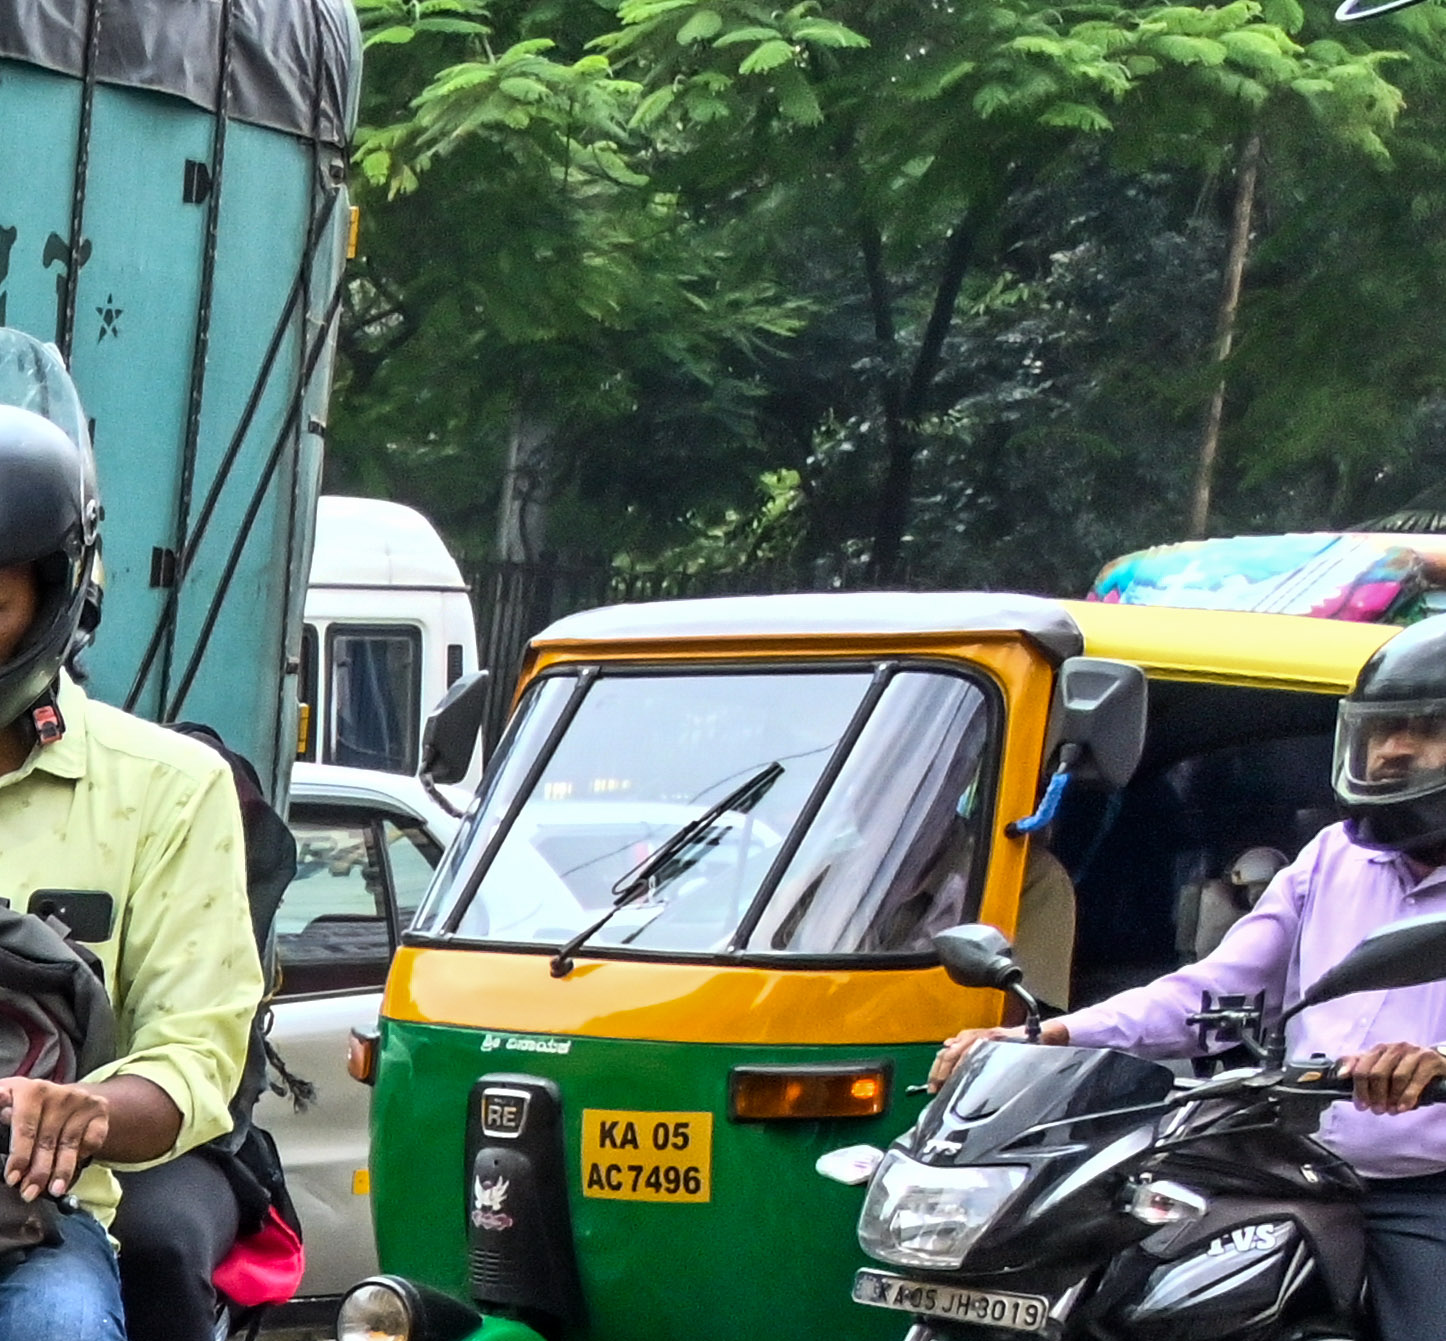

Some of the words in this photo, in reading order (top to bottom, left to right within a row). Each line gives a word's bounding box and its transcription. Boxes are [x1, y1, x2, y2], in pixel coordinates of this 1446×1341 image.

[487, 1104, 518, 1128] RE
[599, 1120, 639, 1150] KA
[652, 1121, 691, 1151] 05
[586, 1162, 703, 1196] AC7496
